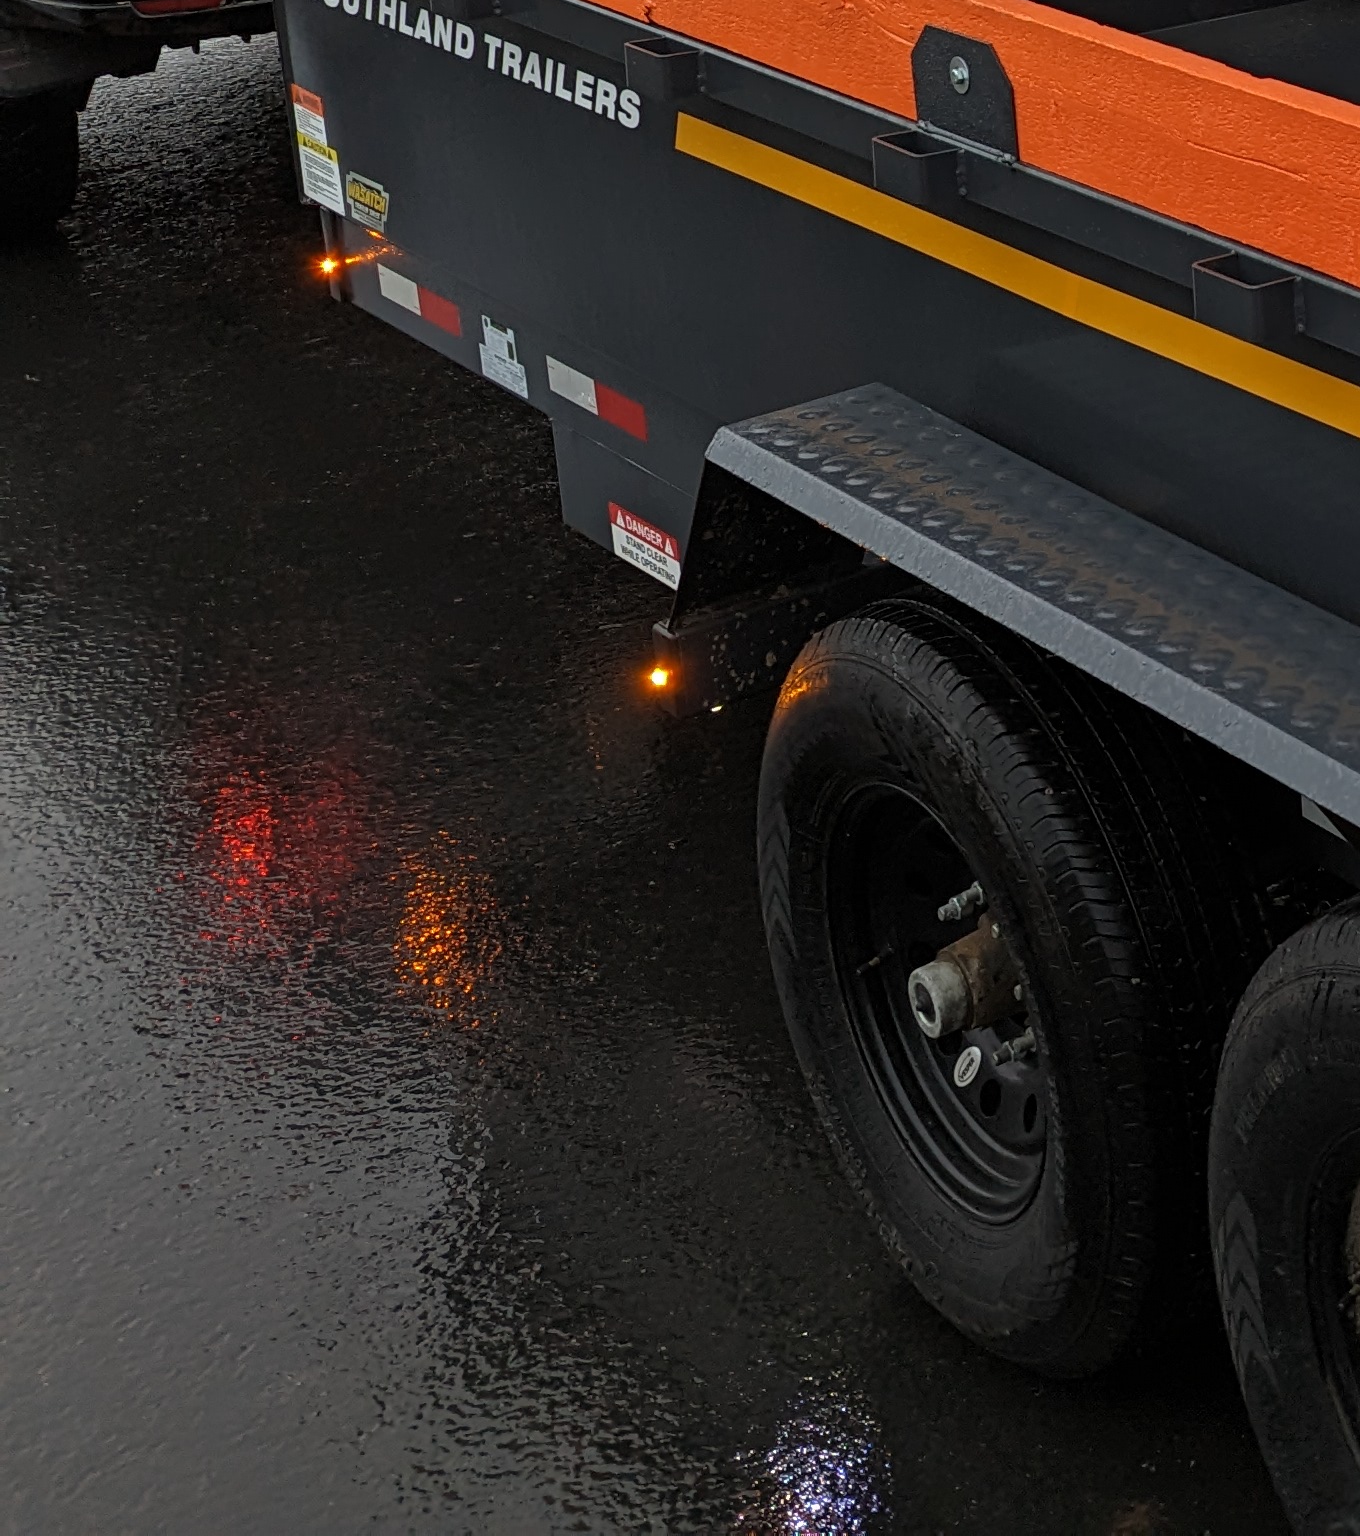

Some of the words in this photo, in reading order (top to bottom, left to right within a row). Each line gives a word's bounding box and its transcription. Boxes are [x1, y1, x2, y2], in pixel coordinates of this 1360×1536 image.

[484, 33, 641, 129] TRAILERS
[348, 180, 386, 214] WASATCH
[625, 515, 664, 549] DANGER
[620, 544, 641, 563] WHILE
[641, 556, 677, 584] OPERATING
[625, 535, 646, 553] STAND
[646, 548, 668, 567] CLEAR
